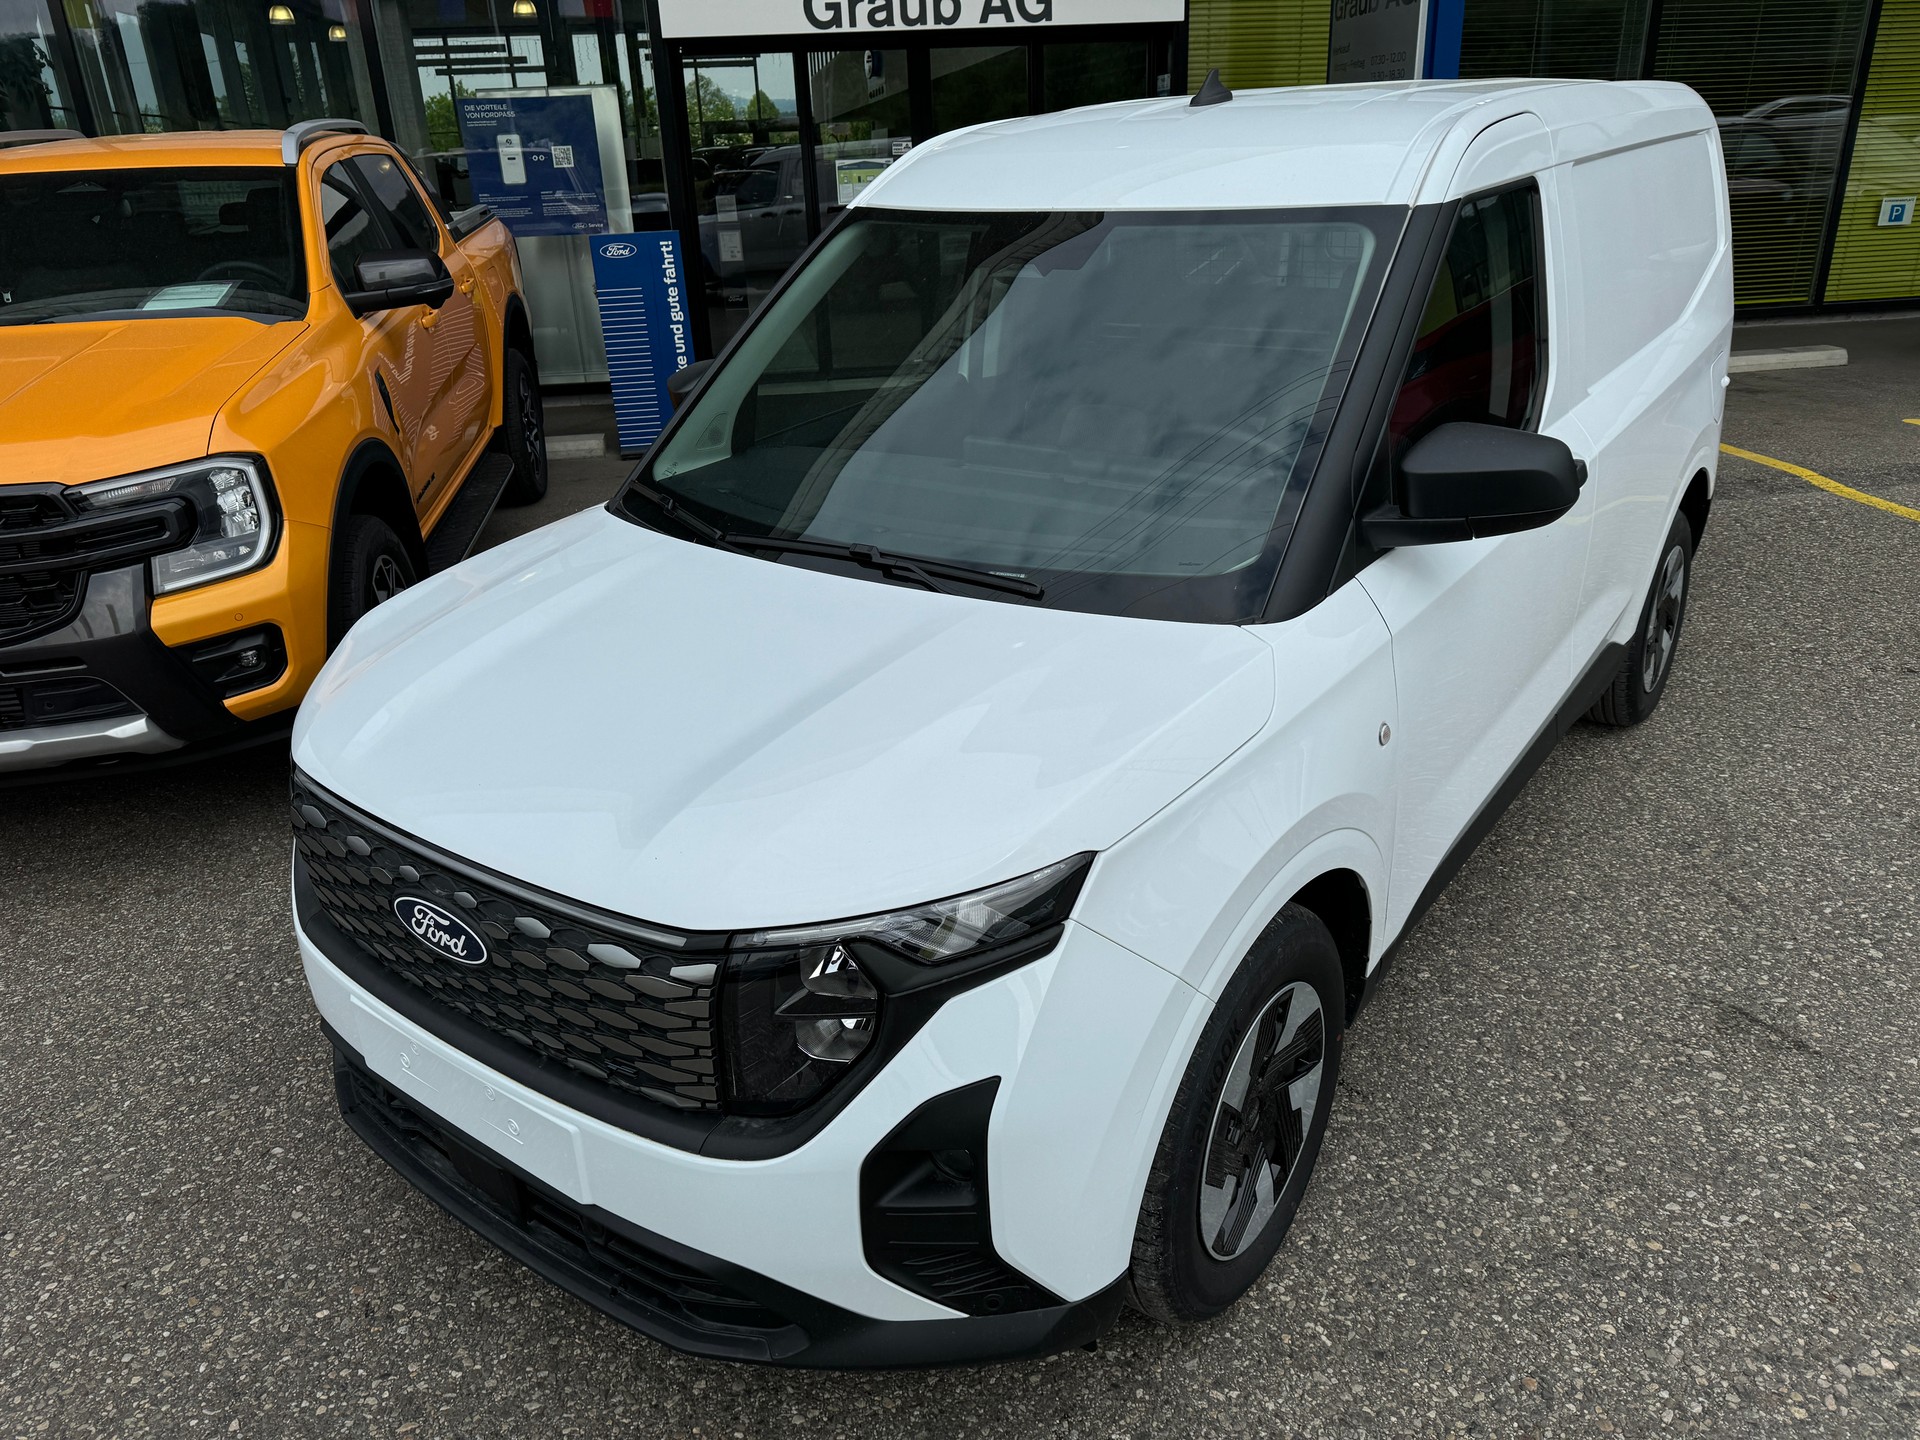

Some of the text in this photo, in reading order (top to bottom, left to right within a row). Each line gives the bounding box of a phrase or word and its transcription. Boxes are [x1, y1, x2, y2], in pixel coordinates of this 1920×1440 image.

[803, 0, 1053, 30] Graub AG
[475, 103, 508, 111] VORTEILE
[1892, 206, 1902, 220] P
[606, 244, 631, 257] Ford
[659, 240, 677, 285] fahrt!
[667, 287, 683, 322] gute
[670, 324, 687, 350] und
[411, 905, 467, 956] Ford
